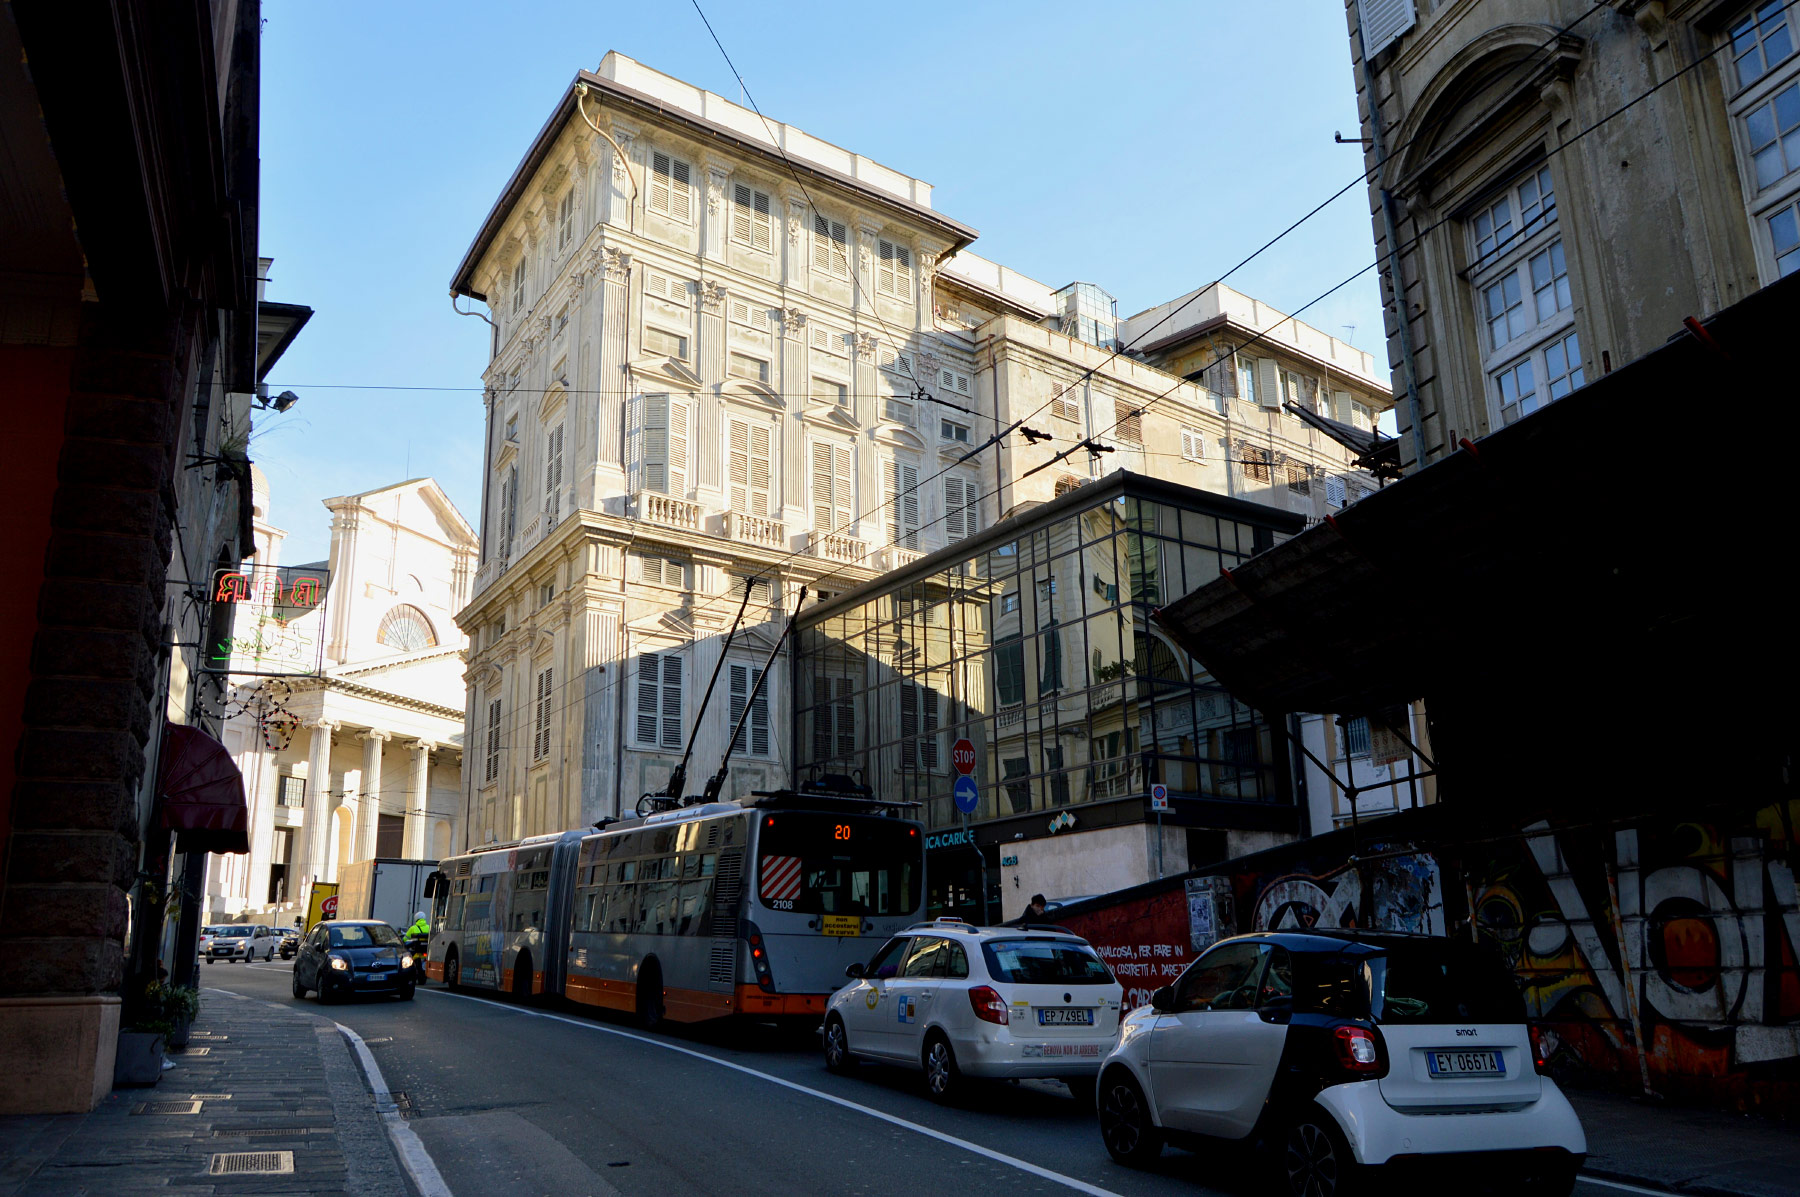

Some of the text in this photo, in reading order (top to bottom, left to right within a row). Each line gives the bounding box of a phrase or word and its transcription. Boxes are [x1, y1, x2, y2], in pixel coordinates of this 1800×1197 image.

[953, 749, 975, 764] STOP
[834, 824, 851, 840] 20
[772, 899, 793, 910] 2108
[1138, 944, 1152, 958] PER
[1153, 944, 1172, 958] FARE
[1174, 944, 1184, 957] IN
[1150, 963, 1158, 976] A
[1161, 962, 1179, 977] DARE
[1044, 1010, 1088, 1022] EP 749EL
[1043, 1045, 1063, 1056] GENOVA
[1063, 1045, 1073, 1056] NON
[1073, 1044, 1079, 1055] SI
[1436, 1053, 1497, 1072] EY 066TA
